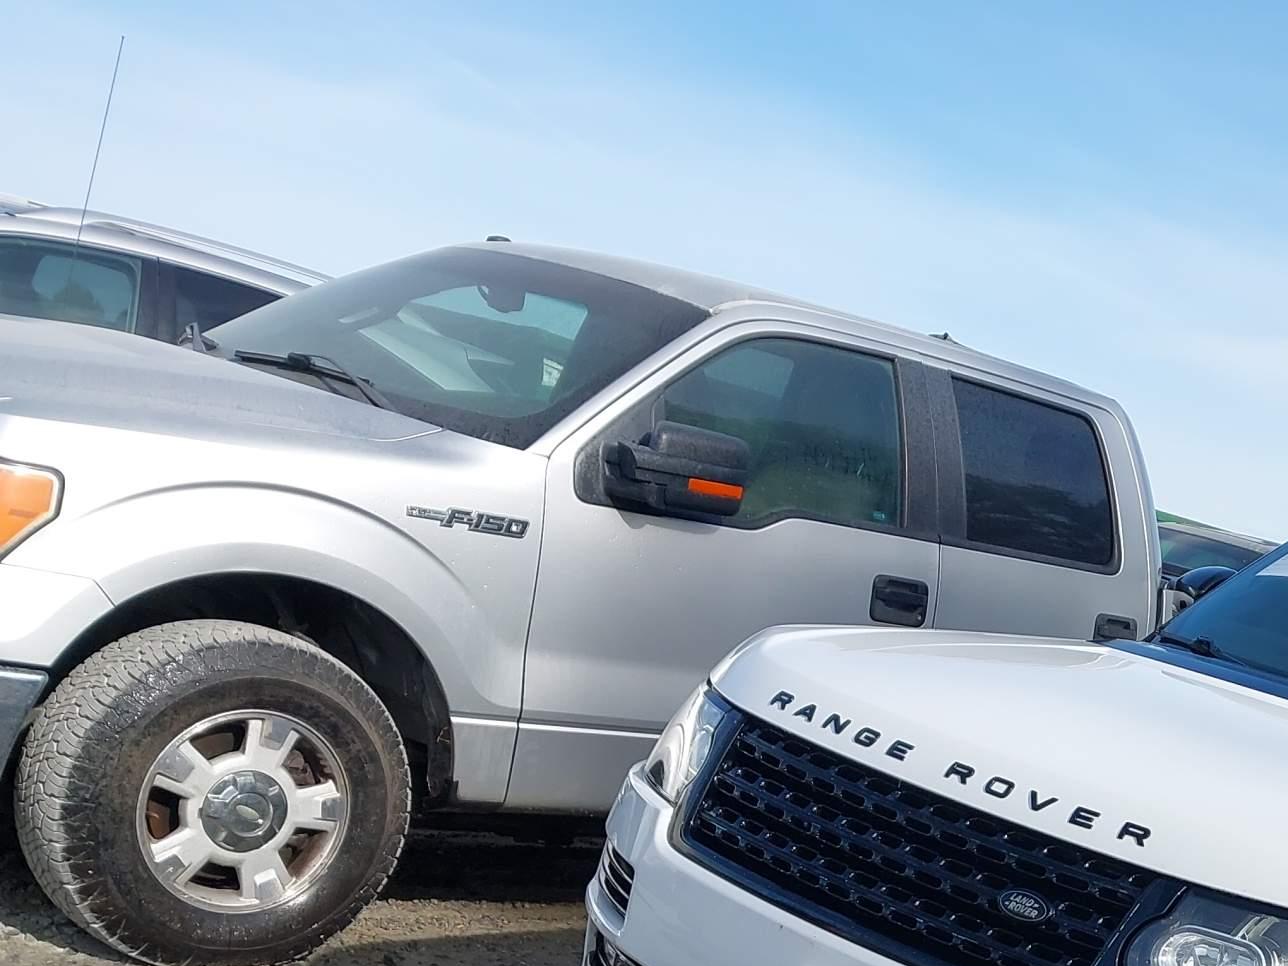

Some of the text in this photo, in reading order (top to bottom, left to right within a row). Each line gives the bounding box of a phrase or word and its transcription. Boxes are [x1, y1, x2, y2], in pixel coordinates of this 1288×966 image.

[440, 509, 530, 538] F-150
[769, 690, 1152, 847] RANGE ROVER
[1007, 901, 1039, 918] ROVER
[1010, 893, 1035, 907] LAND
